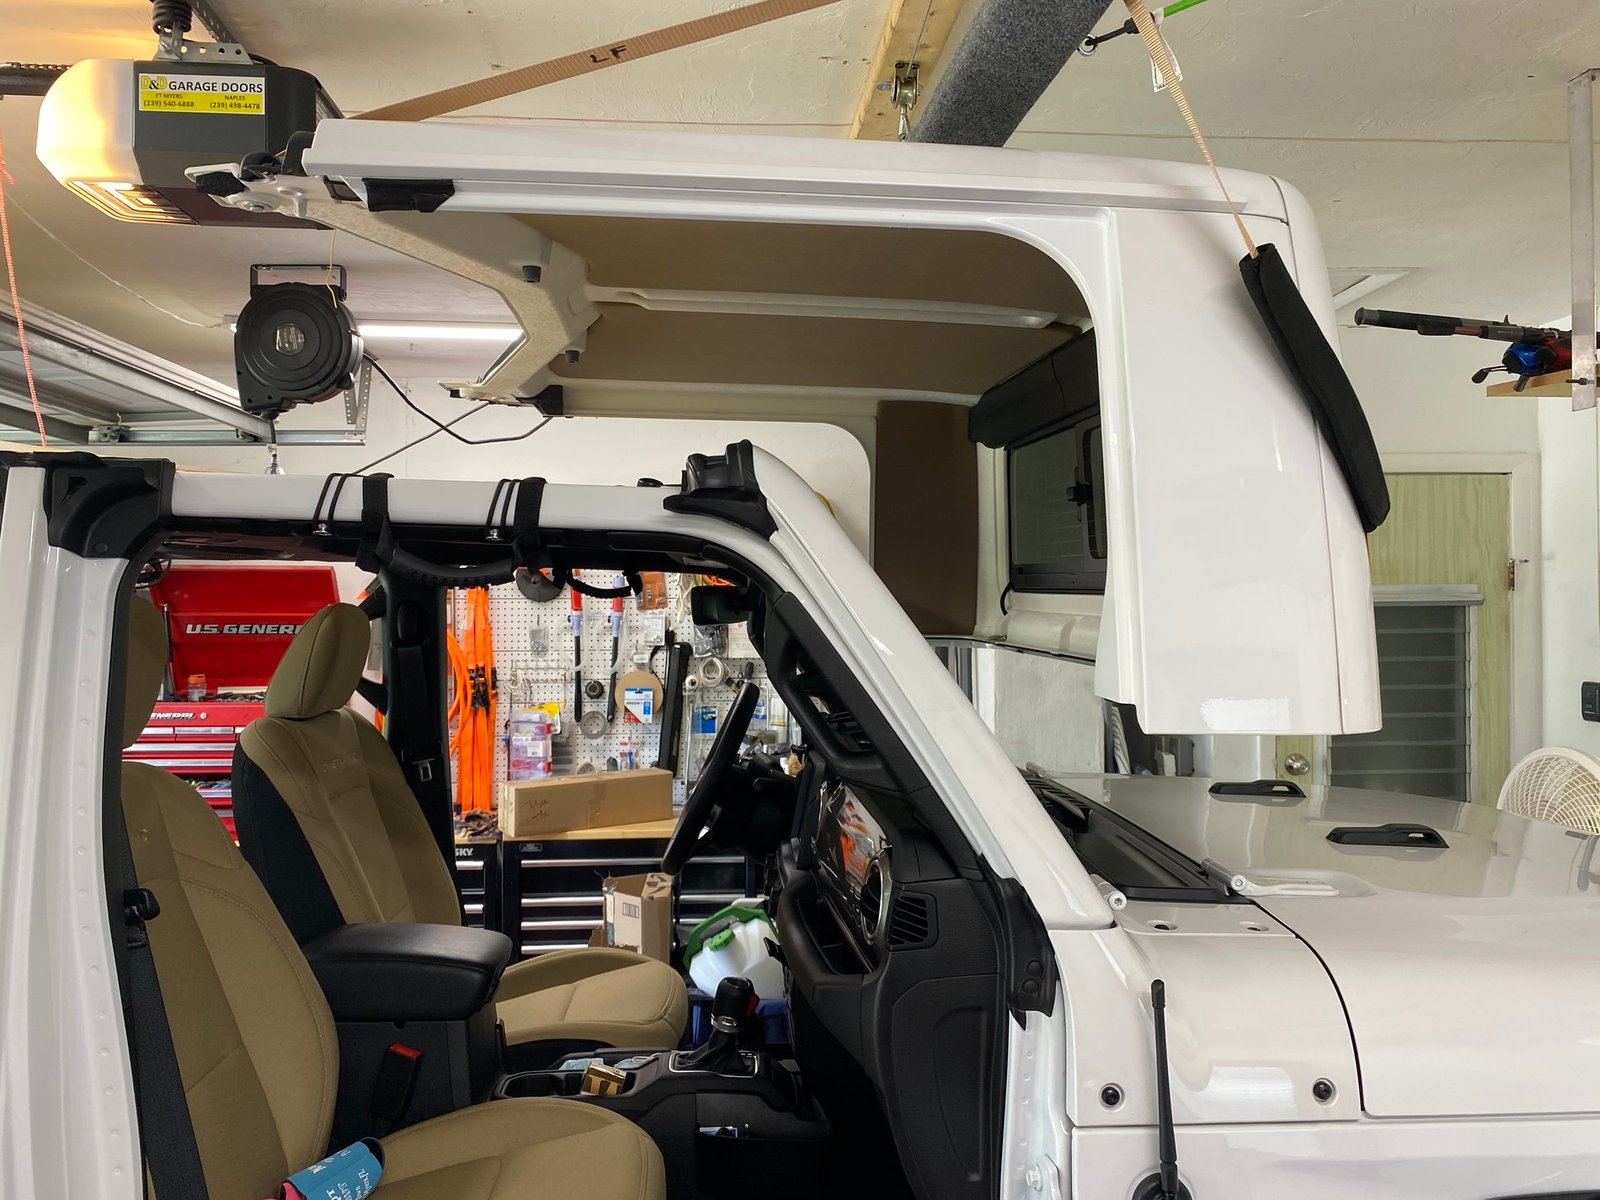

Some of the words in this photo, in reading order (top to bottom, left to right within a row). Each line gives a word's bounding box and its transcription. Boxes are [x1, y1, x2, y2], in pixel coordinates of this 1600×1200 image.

[590, 44, 627, 63] LF
[140, 75, 168, 90] D&D
[168, 81, 218, 92] GARAGE
[221, 82, 263, 93] DOORS
[143, 99, 162, 107] (239)
[210, 101, 228, 109] (239)
[229, 102, 261, 110] 498-4478
[186, 623, 220, 634] U.S.
[222, 623, 304, 635] GENER
[455, 847, 474, 857] SKY
